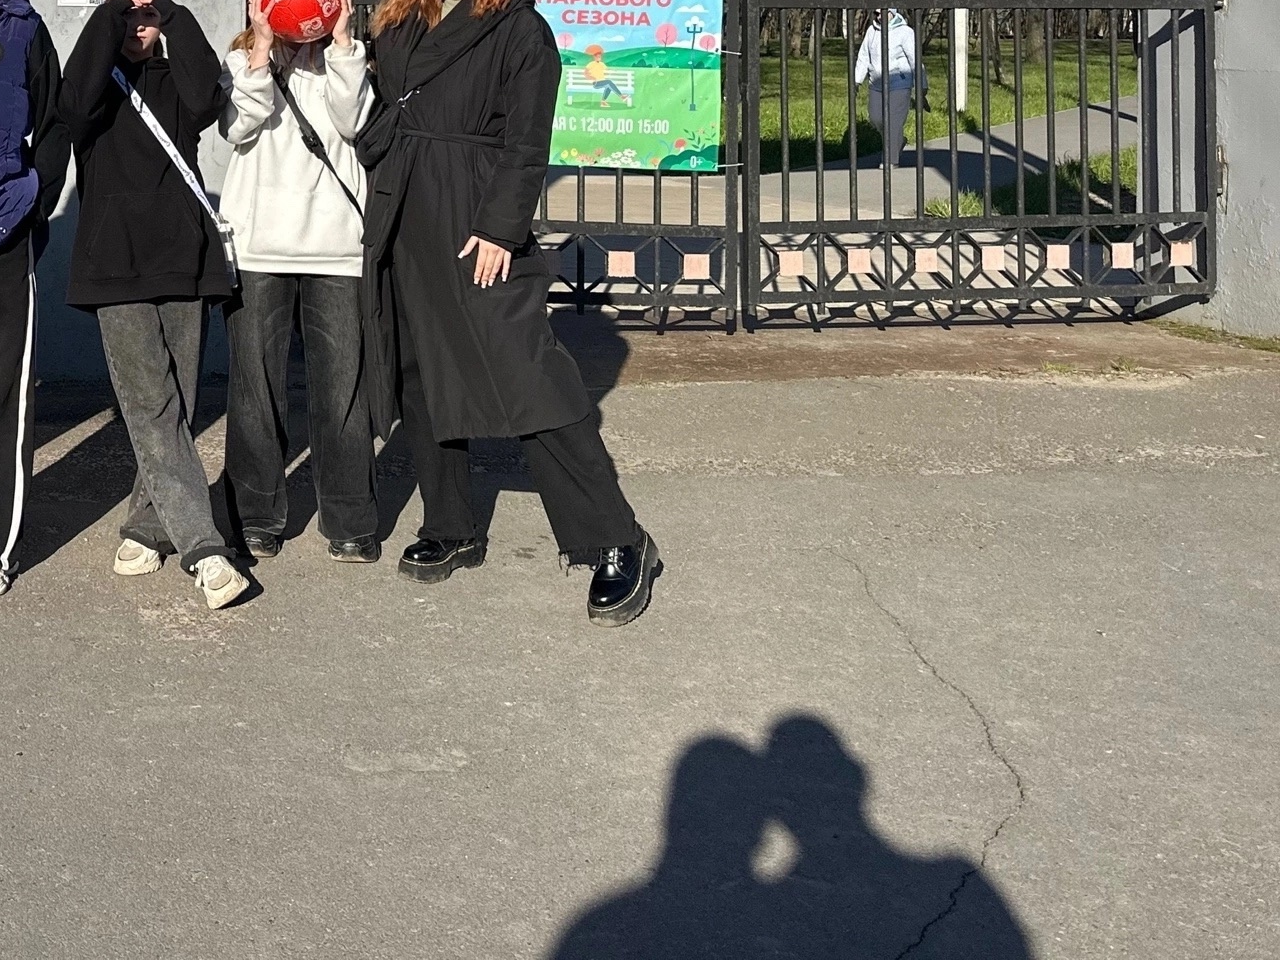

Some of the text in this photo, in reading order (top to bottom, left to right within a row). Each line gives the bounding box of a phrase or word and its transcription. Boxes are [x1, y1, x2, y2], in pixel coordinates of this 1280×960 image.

[561, 9, 651, 26] СЕЗОНА
[552, 116, 669, 135] АЯ С 12:00 ДО 15:00
[689, 155, 703, 168] 0+
